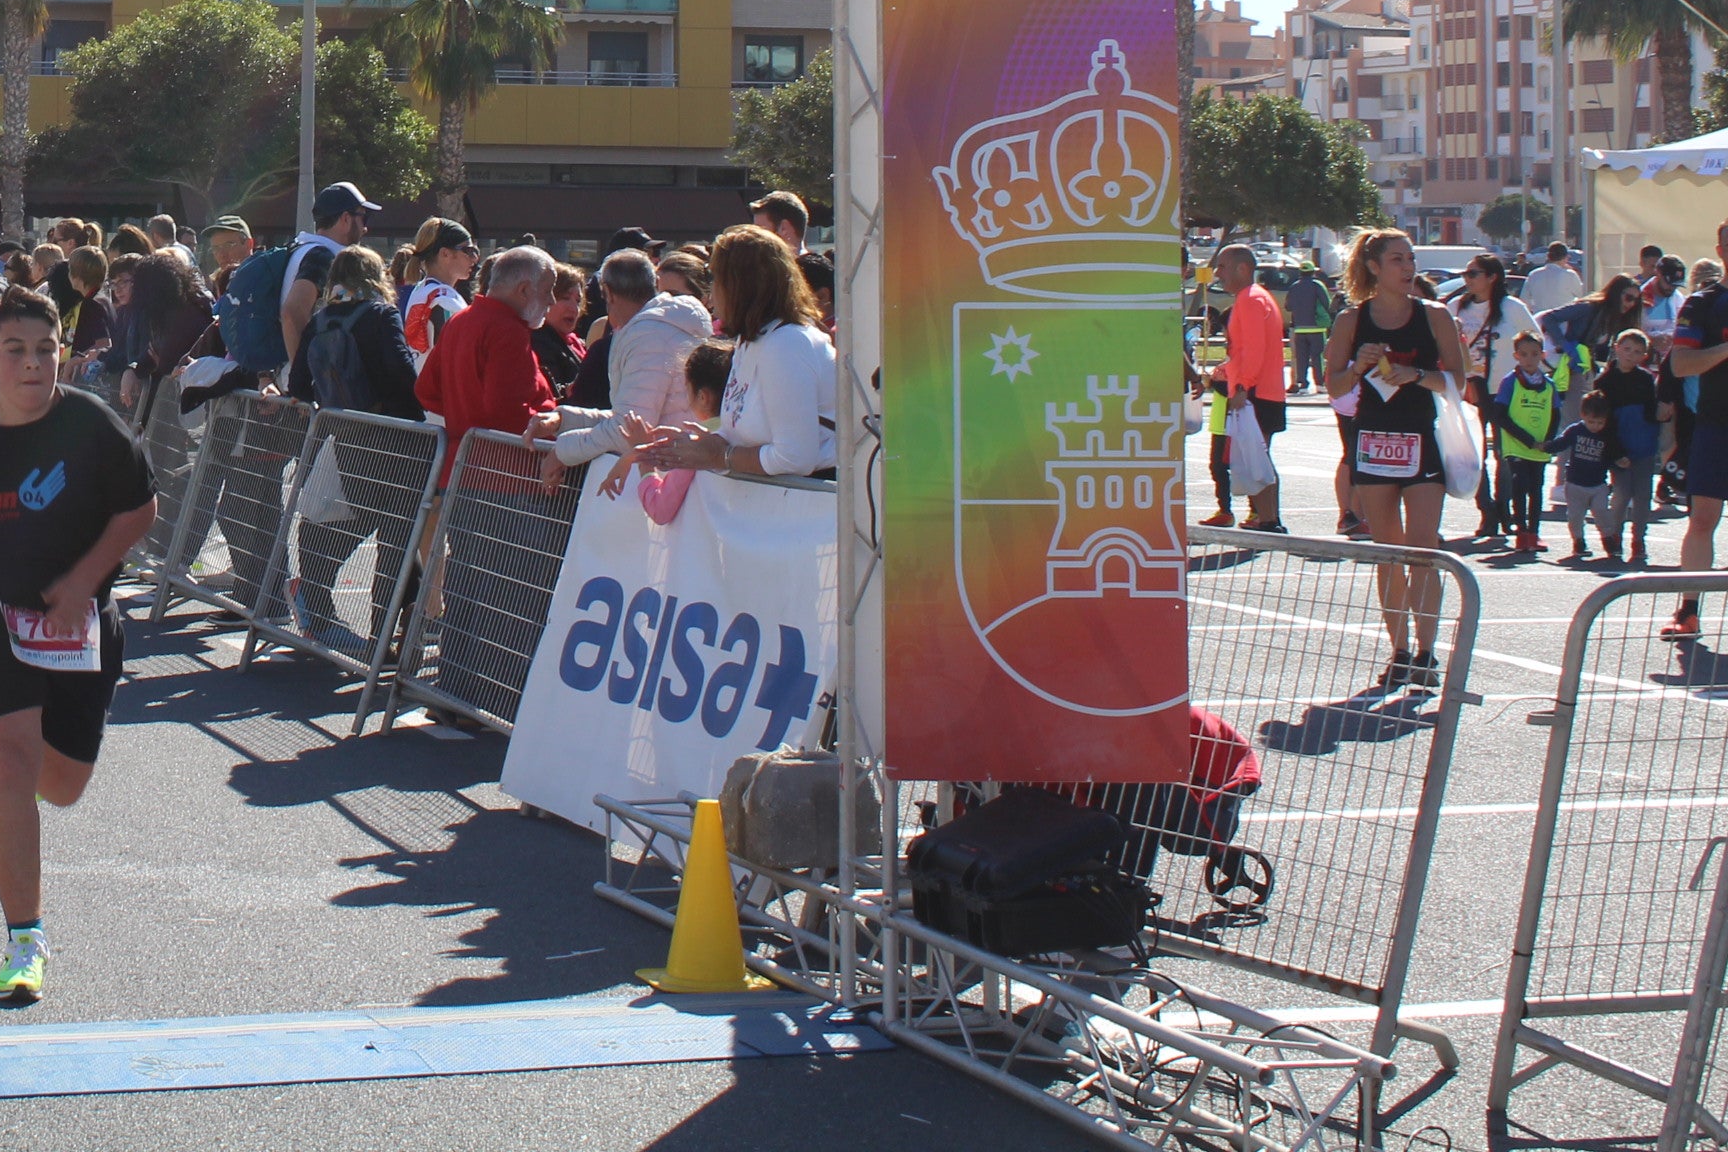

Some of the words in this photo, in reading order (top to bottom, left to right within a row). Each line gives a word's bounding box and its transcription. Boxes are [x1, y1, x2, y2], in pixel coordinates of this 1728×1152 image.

[1576, 434, 1605, 448] WILD
[1374, 444, 1404, 459] 700
[1575, 444, 1603, 457] DUDE
